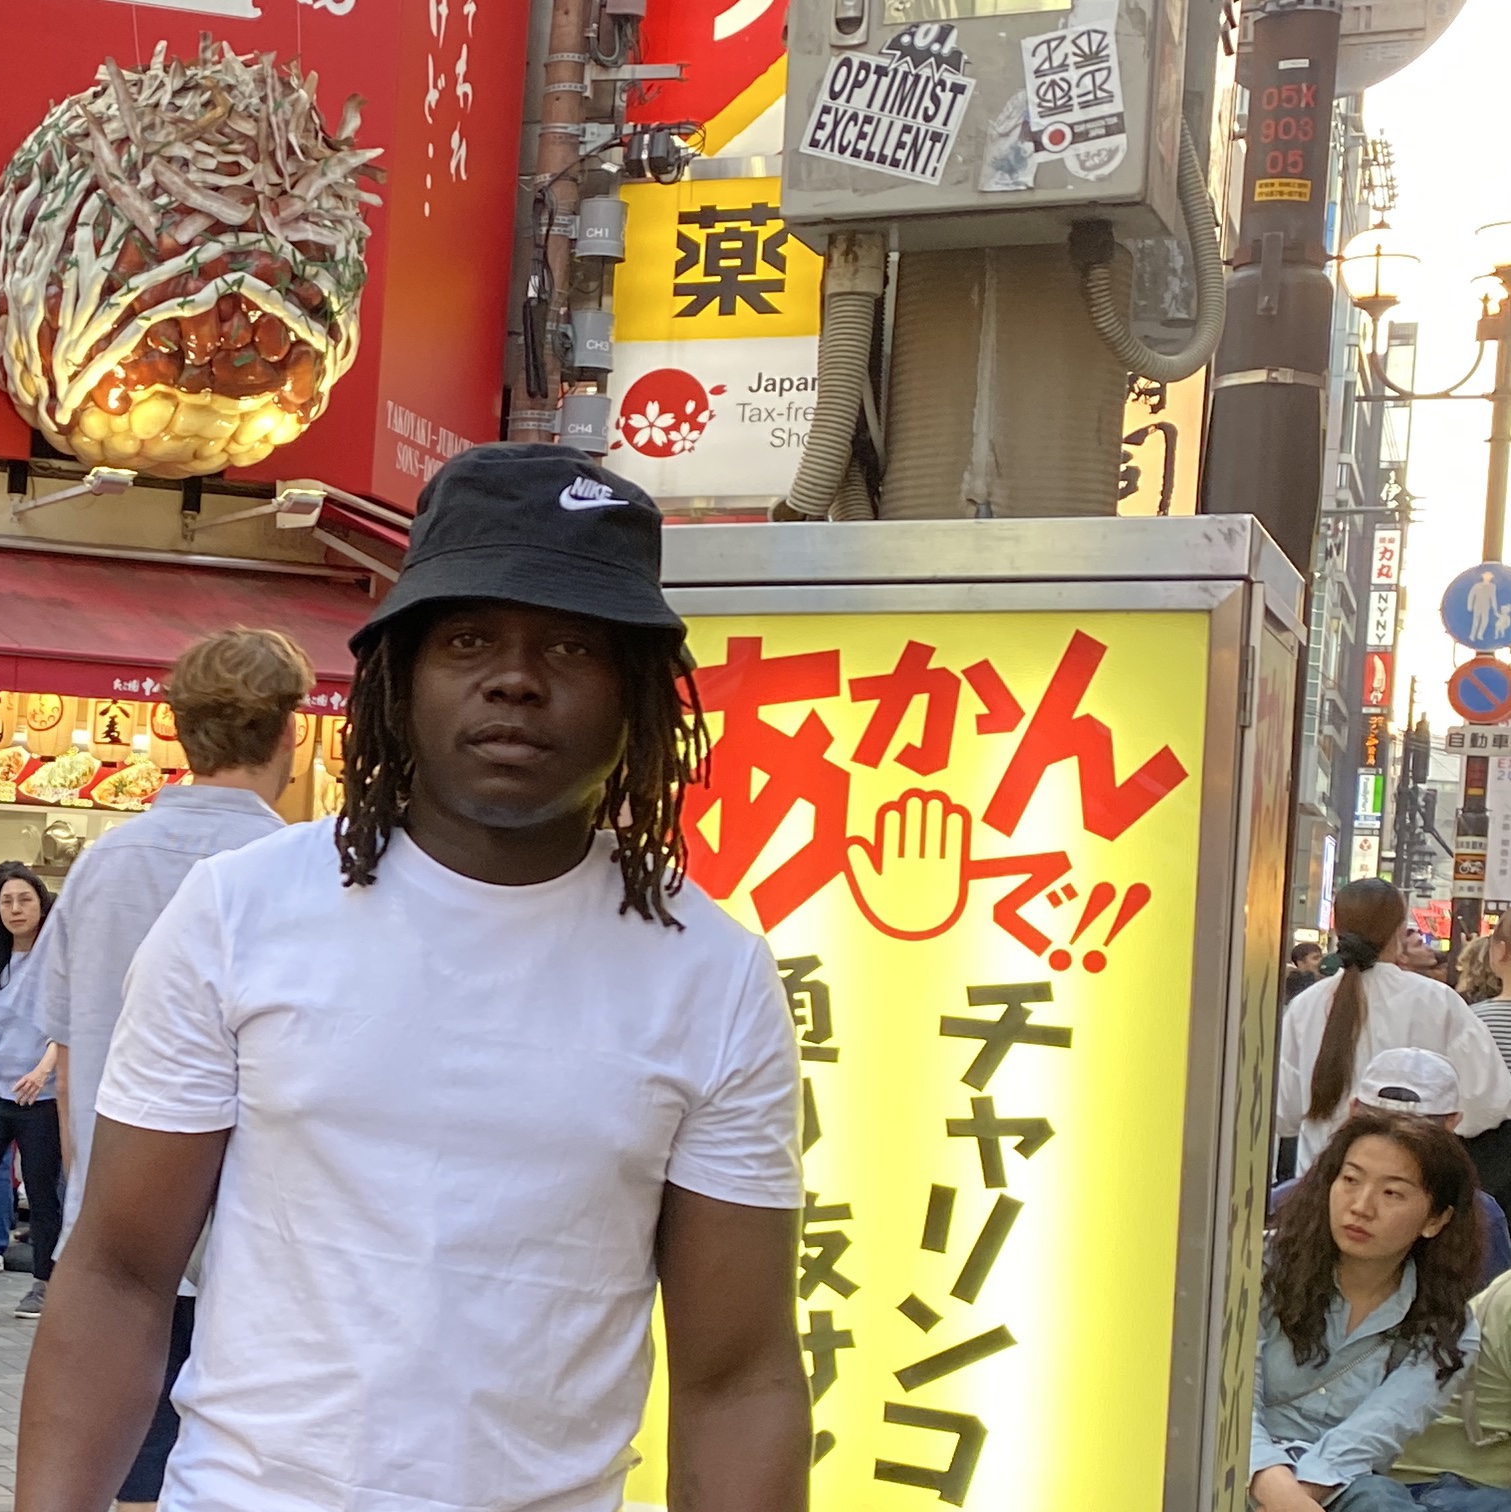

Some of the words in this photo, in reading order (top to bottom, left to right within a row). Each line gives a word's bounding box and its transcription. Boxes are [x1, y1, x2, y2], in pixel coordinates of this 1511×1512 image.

[829, 56, 967, 128] OPTIMIST
[808, 104, 950, 178] EXCELLENT!
[585, 227, 610, 239] CH1
[671, 201, 787, 318] 薬
[585, 339, 610, 351] CH3
[567, 423, 593, 434] CH4
[570, 476, 613, 500] NIKE
[1448, 732, 1510, 749] 自動車
[680, 629, 1190, 935] あかん
[875, 981, 1073, 1507] チャリンコ
